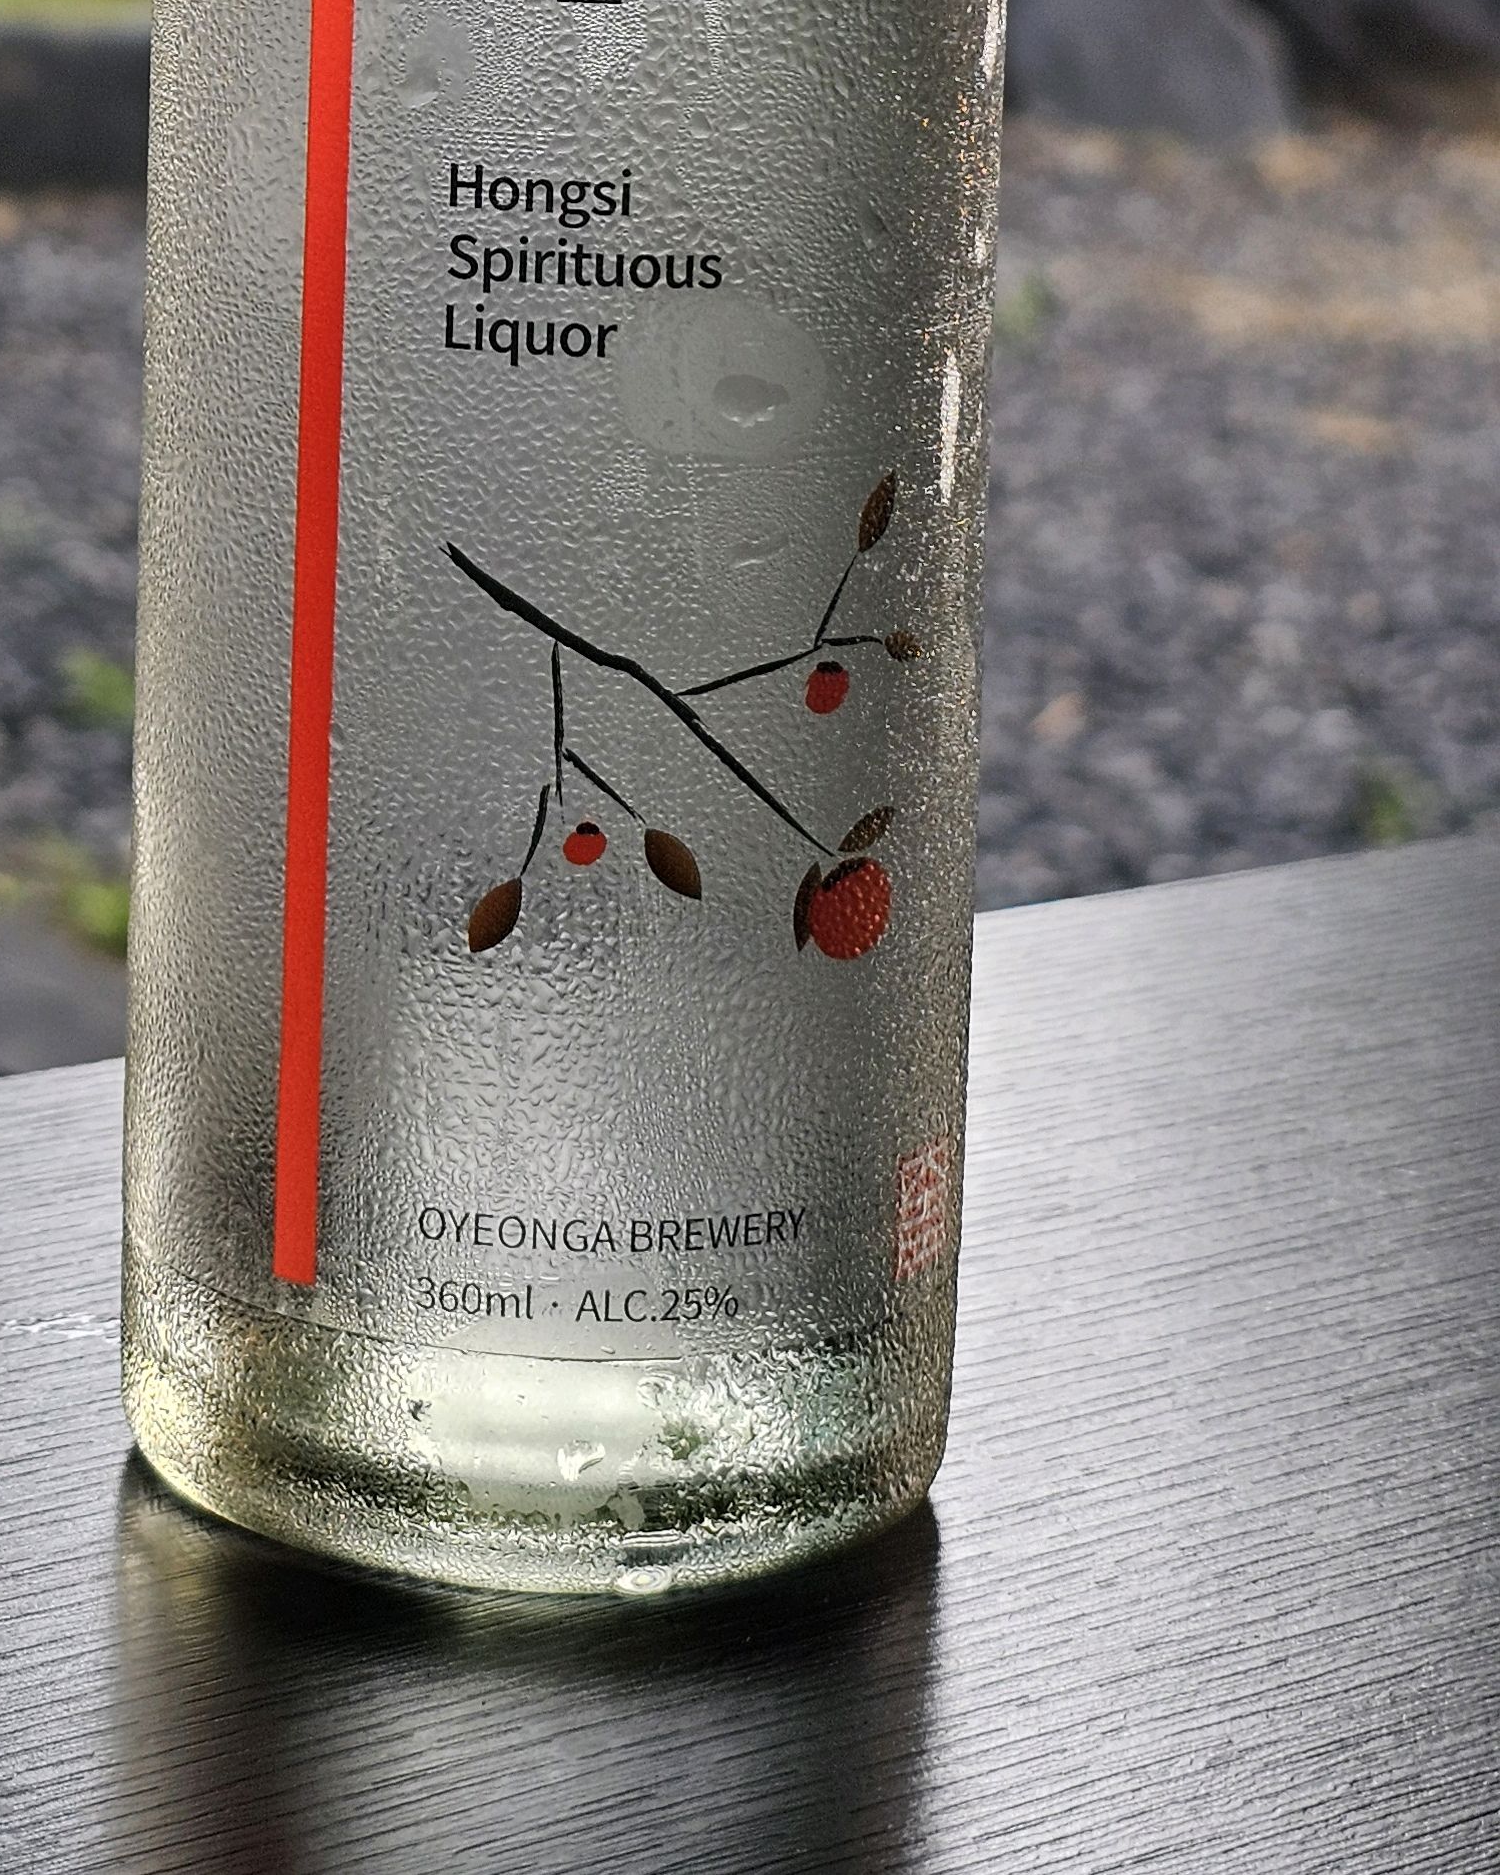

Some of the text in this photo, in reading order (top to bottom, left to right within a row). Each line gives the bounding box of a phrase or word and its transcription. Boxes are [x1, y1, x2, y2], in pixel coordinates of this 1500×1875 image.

[448, 162, 632, 228] Hongsi
[447, 233, 723, 293] Spirituous
[444, 303, 618, 366] Liquor
[418, 1206, 806, 1253] OYEONGA BREWERY
[416, 1276, 533, 1320] 360ml
[575, 1285, 740, 1323] ALC.25%
